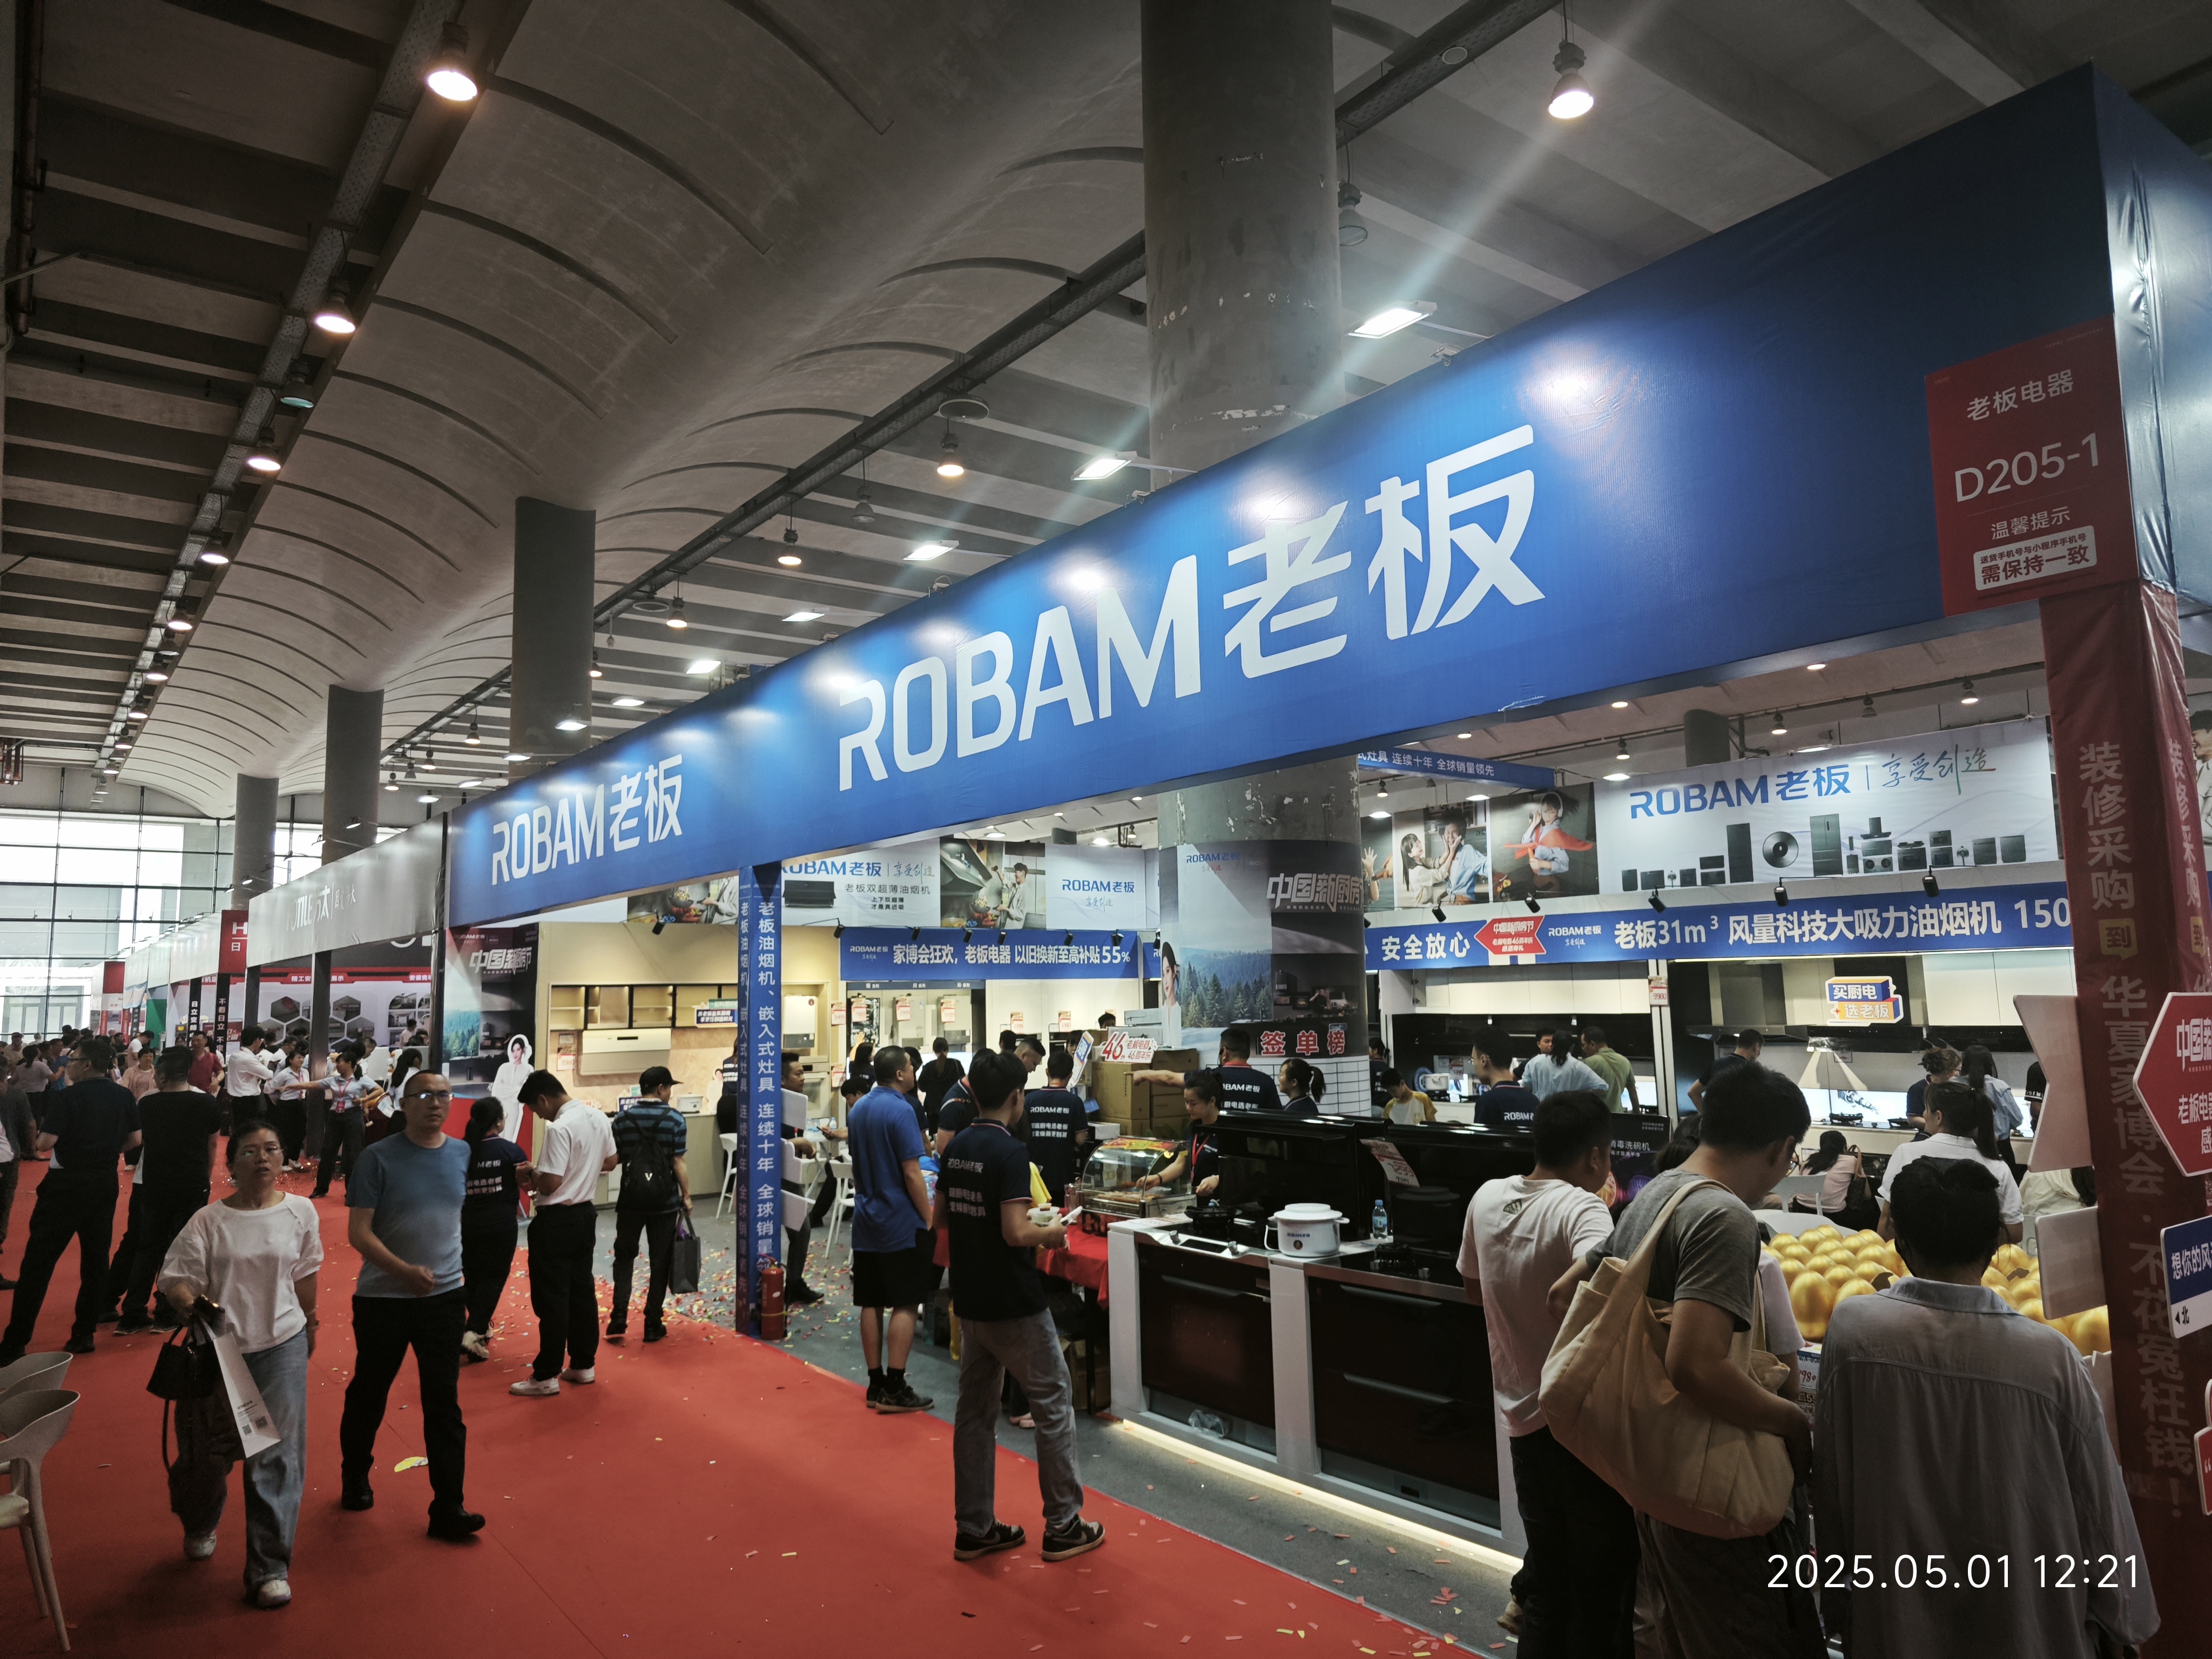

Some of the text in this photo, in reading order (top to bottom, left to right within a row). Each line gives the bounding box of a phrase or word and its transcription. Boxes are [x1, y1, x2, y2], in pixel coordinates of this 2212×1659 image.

[1967, 369, 2074, 421] 老板电器
[1955, 432, 2099, 503] D205-1
[1991, 506, 2071, 540] 温馨提示
[1980, 532, 2087, 564] 送货手机号与小程序手机号
[1981, 544, 2089, 585] 需保持一致
[838, 424, 1546, 792] ROBAM 老板
[1392, 752, 1433, 768] 连续十年
[1437, 759, 1494, 777] 全球销量领先
[1630, 744, 1997, 819] ROBAM 老板 享受创造
[492, 754, 683, 886] ROBAM 老板
[782, 861, 935, 884] OBAM 老板 享受创造
[1186, 853, 1220, 863] ROBAM
[845, 884, 930, 895] 老板双超薄油烟机
[1062, 879, 1135, 893] ROBAM 老板
[1266, 873, 1363, 912] 中国新厨房
[1548, 925, 1601, 936] ROBAM 老板
[1729, 901, 2001, 946] 风量科技大吸力油烟机
[1381, 932, 1471, 961] 安全放心
[1832, 984, 1878, 1000] 买厨电
[1844, 1003, 1890, 1019] 选老板
[1260, 1029, 1346, 1056] 签单榜
[1503, 1111, 1529, 1121] ROBAM
[757, 1103, 775, 1172] 连续十年
[2171, 1241, 2212, 1280] 想你的风
[2182, 1306, 2190, 1325] 北
